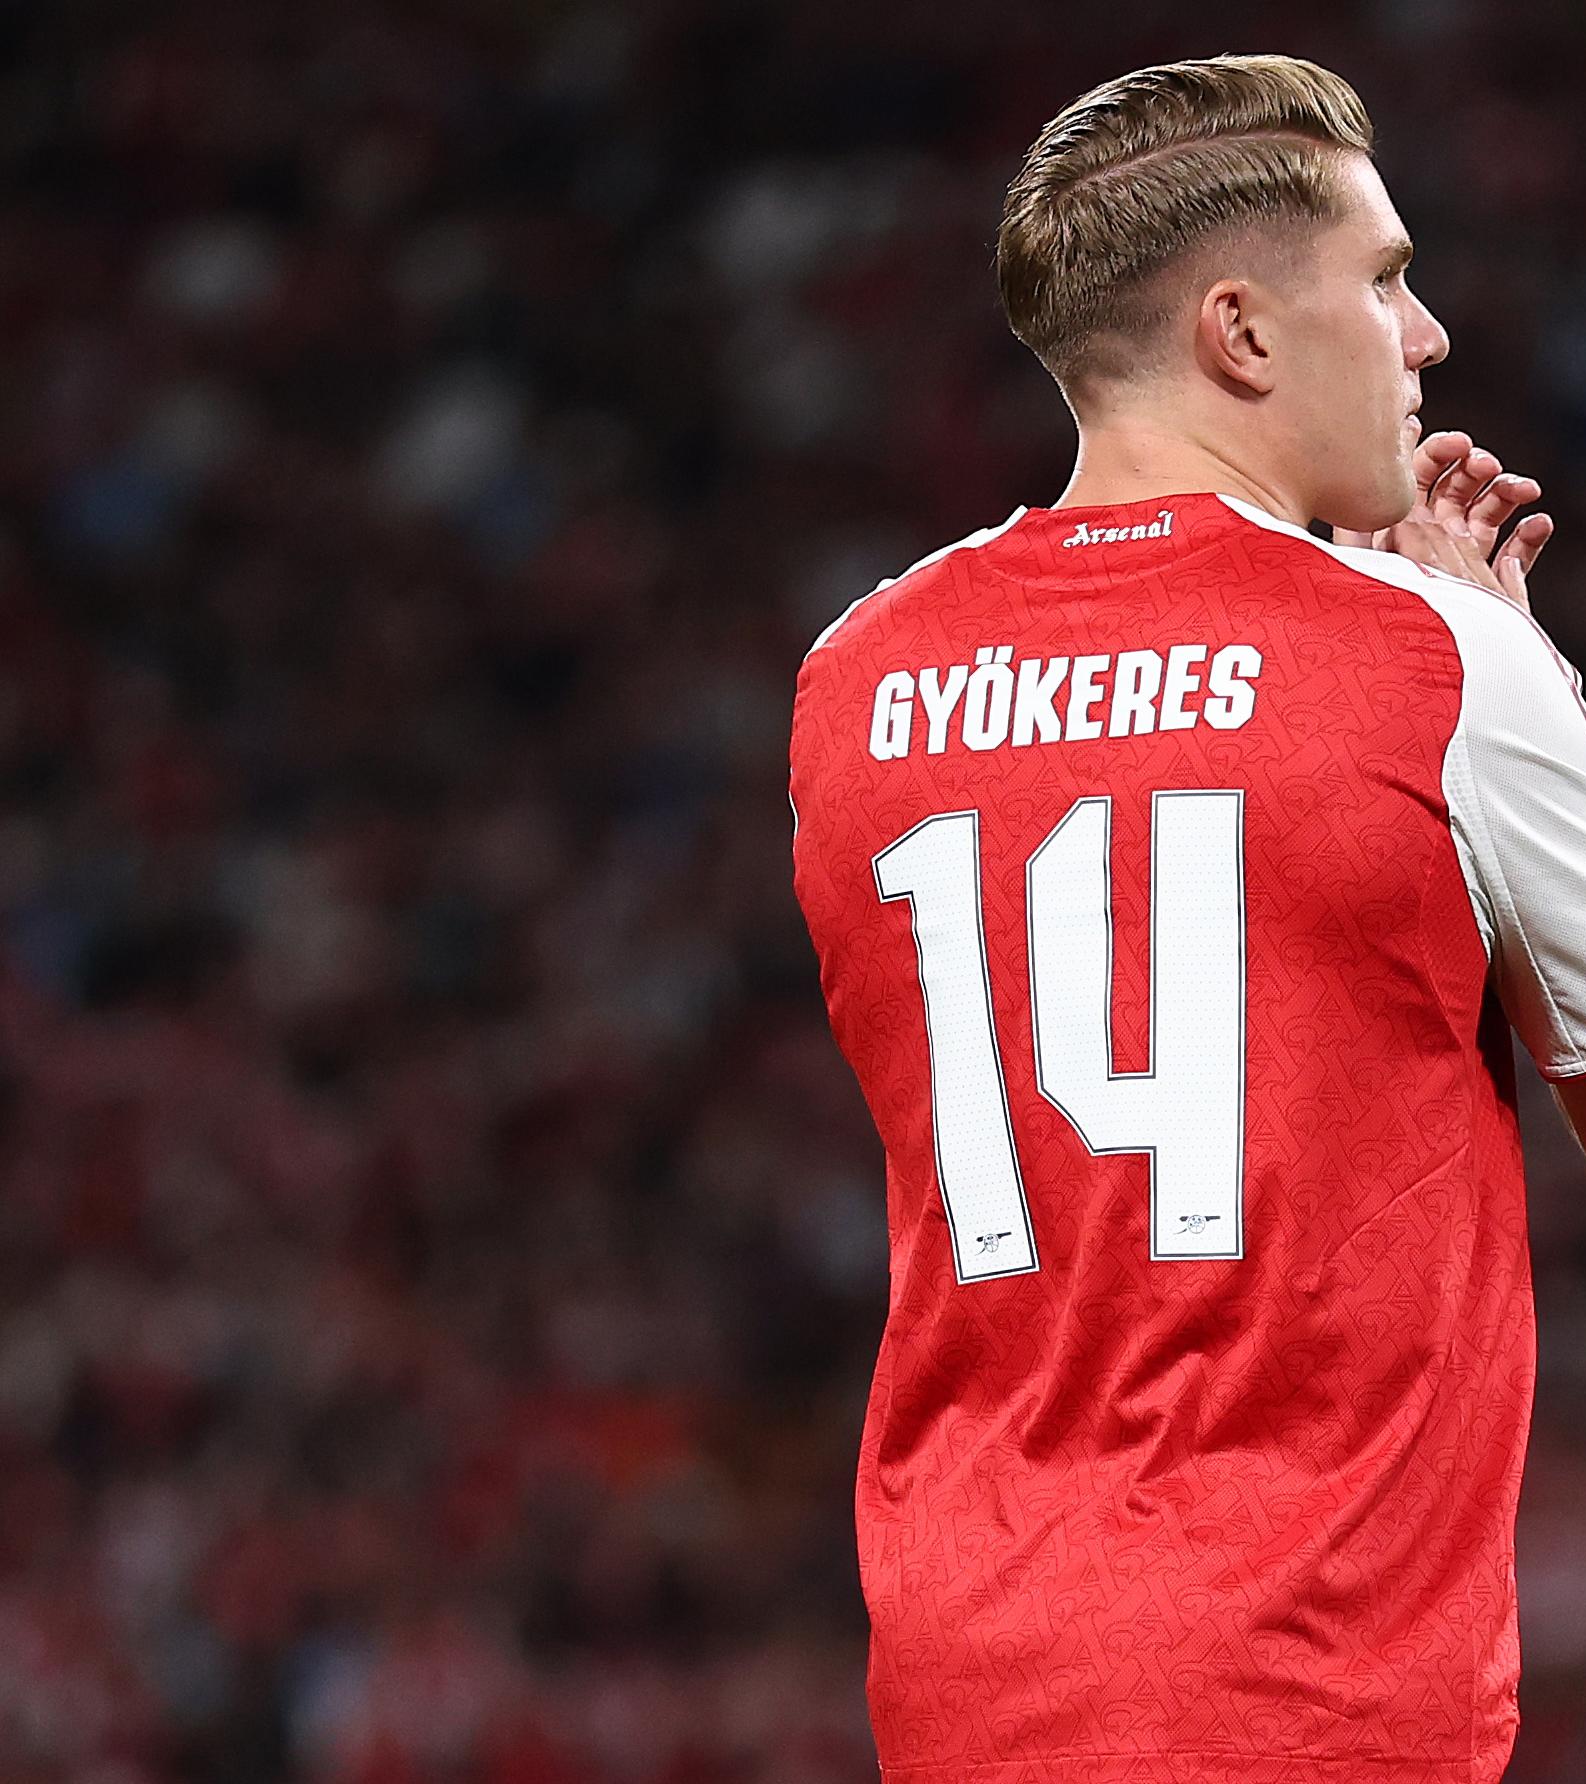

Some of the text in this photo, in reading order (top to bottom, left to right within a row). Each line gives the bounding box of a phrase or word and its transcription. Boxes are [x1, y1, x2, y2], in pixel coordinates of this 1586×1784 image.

[1062, 510, 1174, 548] Arsenal
[868, 644, 1262, 761] GYÖKERES
[871, 789, 1244, 1285] 14
